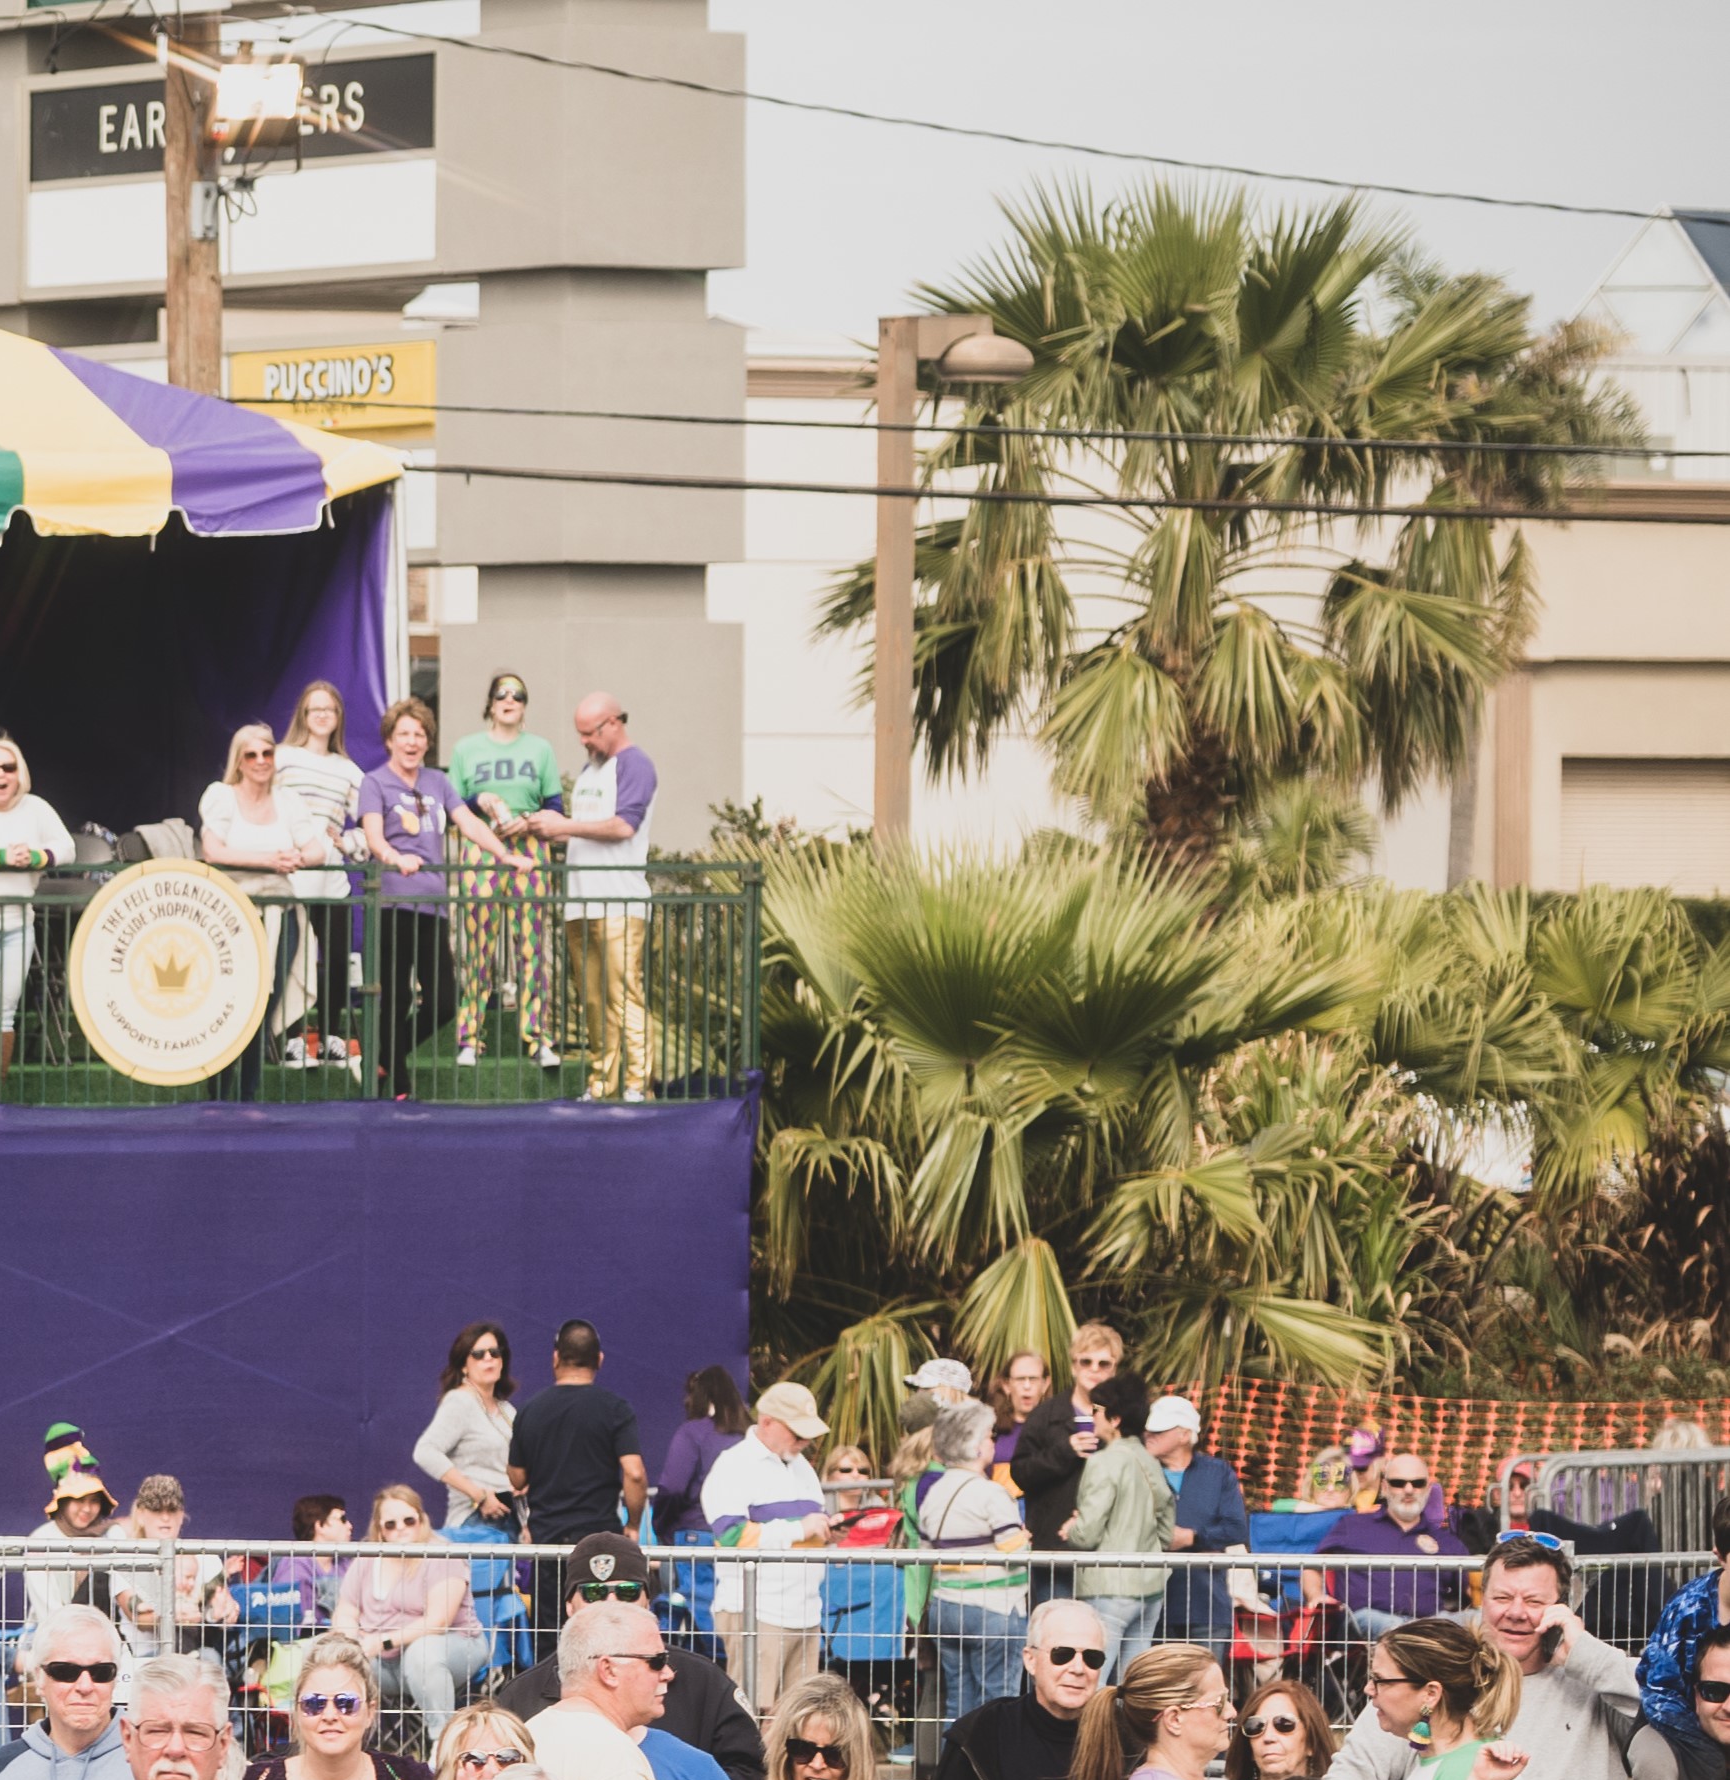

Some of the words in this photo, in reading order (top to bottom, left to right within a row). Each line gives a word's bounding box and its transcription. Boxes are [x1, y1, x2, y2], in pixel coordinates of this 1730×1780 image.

[264, 354, 394, 401] PUCCINO'S
[473, 760, 538, 785] 504
[102, 909, 125, 935] THE
[155, 881, 243, 937] ORGANIZATION
[110, 914, 148, 974] LAKESIDE
[149, 902, 209, 927] SHOPPING
[208, 923, 234, 977] CENTER
[107, 1000, 160, 1050] SUPPORTS
[164, 1031, 210, 1051] FAMILY
